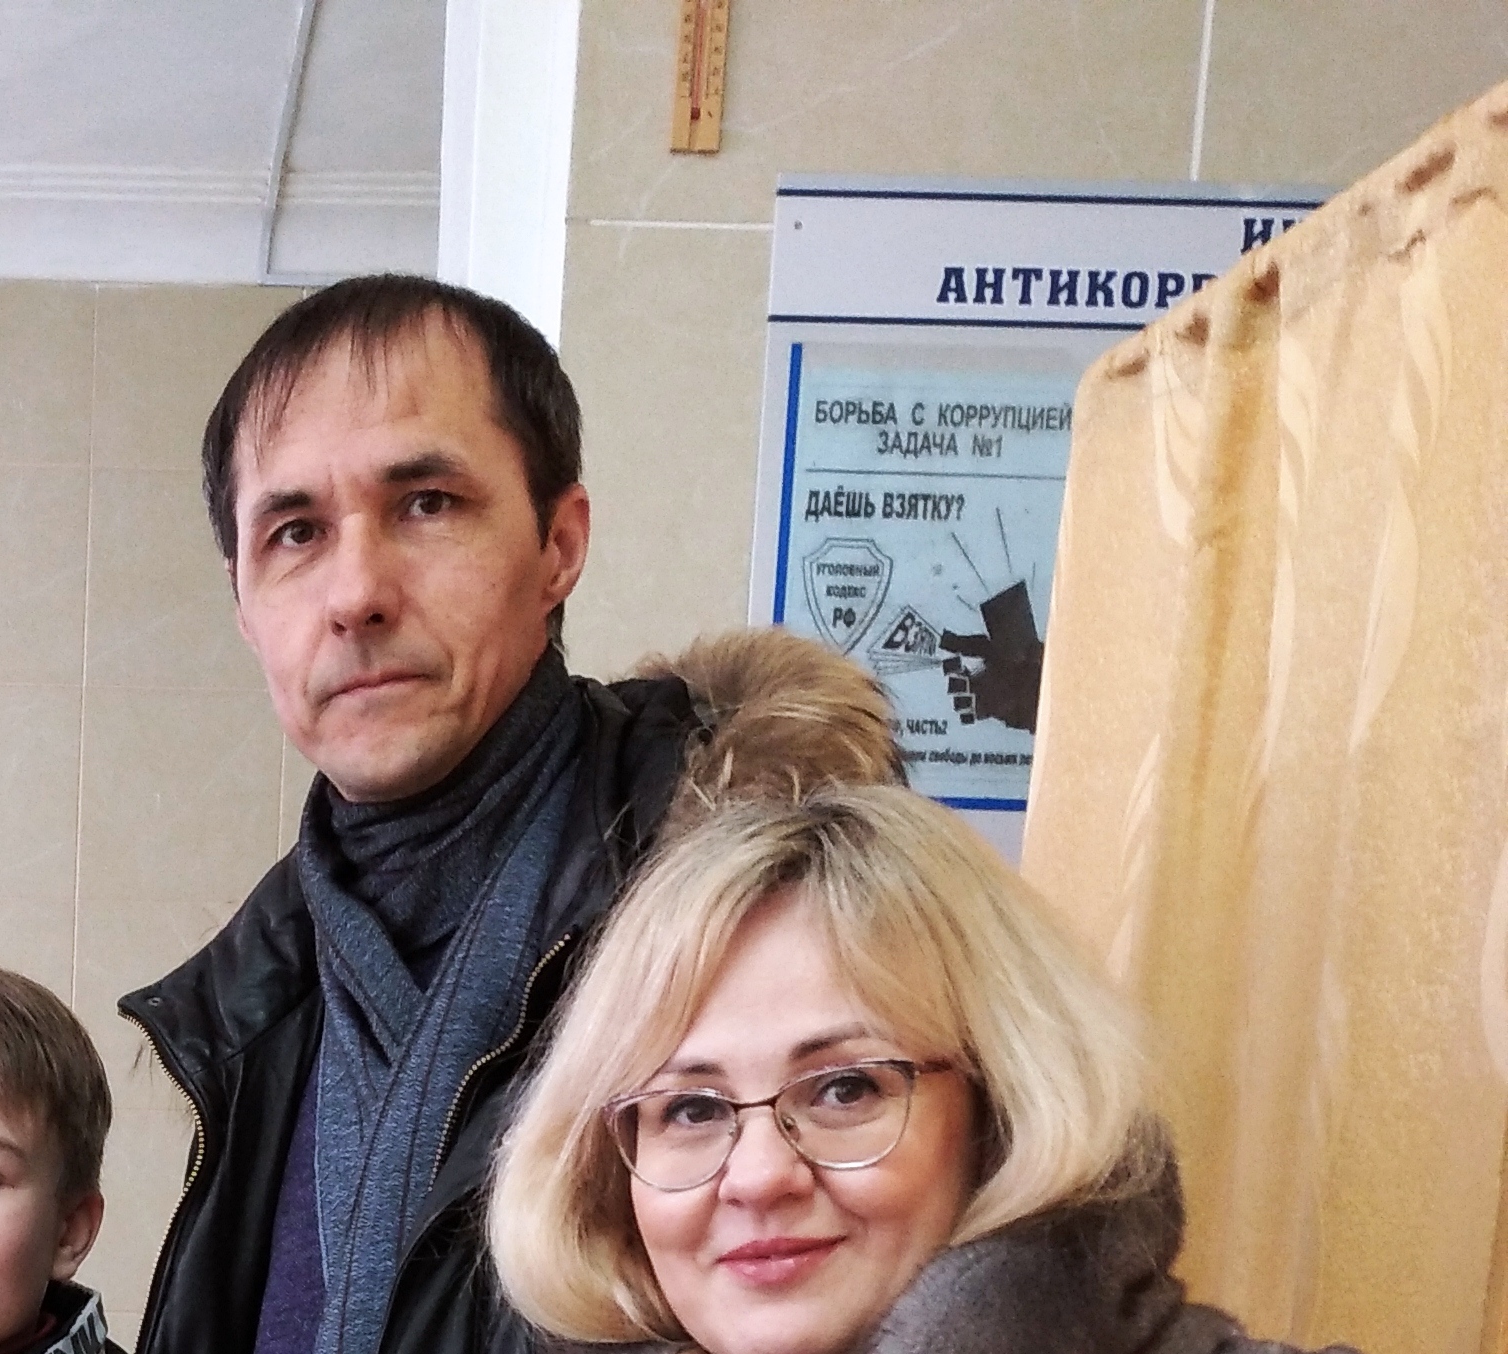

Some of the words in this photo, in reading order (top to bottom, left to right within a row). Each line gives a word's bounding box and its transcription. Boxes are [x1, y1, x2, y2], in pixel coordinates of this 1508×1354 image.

[1240, 217, 1298, 255] И
[815, 400, 897, 426] БОРЬБА
[912, 403, 926, 426] С
[937, 402, 1073, 432] КОРРУПЦИЕЙ
[876, 432, 958, 458] ЗАДАЧА
[972, 435, 1003, 458] №1
[805, 486, 876, 522] ДАЁШЬ
[882, 493, 966, 521] ВЗЯТКУ?
[832, 607, 856, 628] РФ
